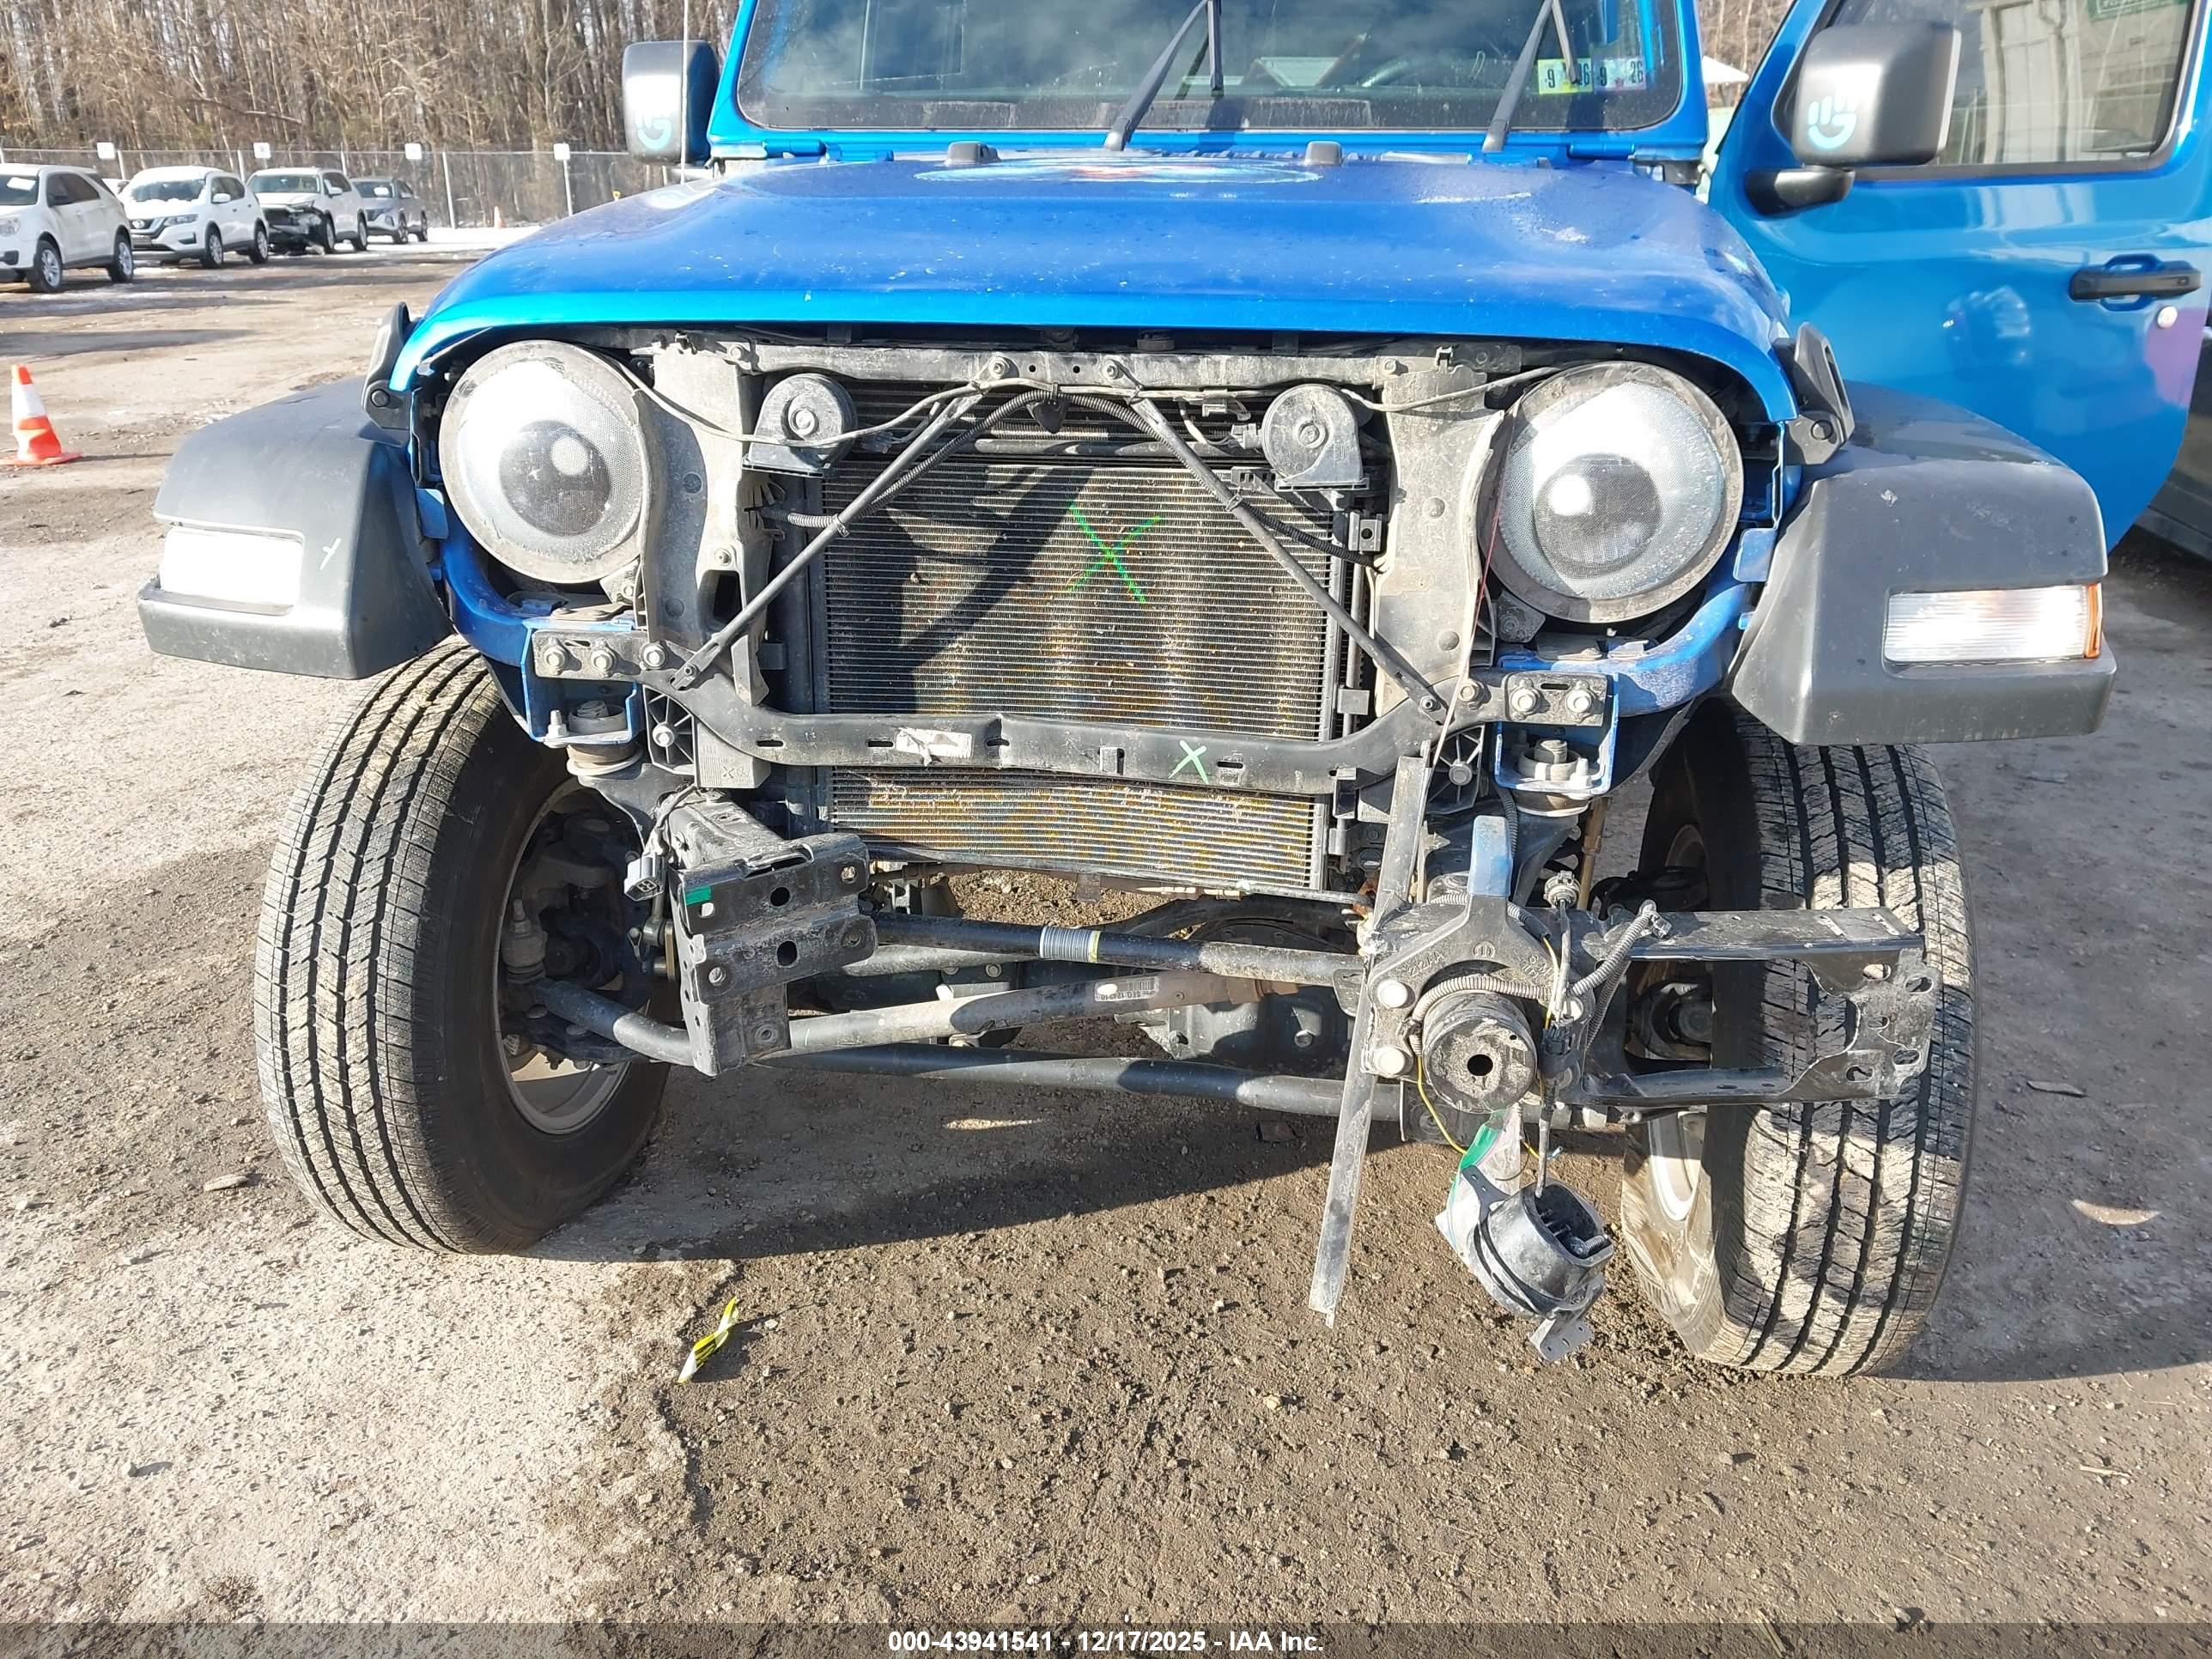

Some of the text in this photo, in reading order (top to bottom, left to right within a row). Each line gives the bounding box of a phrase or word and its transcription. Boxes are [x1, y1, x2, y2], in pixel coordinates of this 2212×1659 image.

[1547, 69, 1555, 88] 9
[1600, 61, 1644, 87] 9 26
